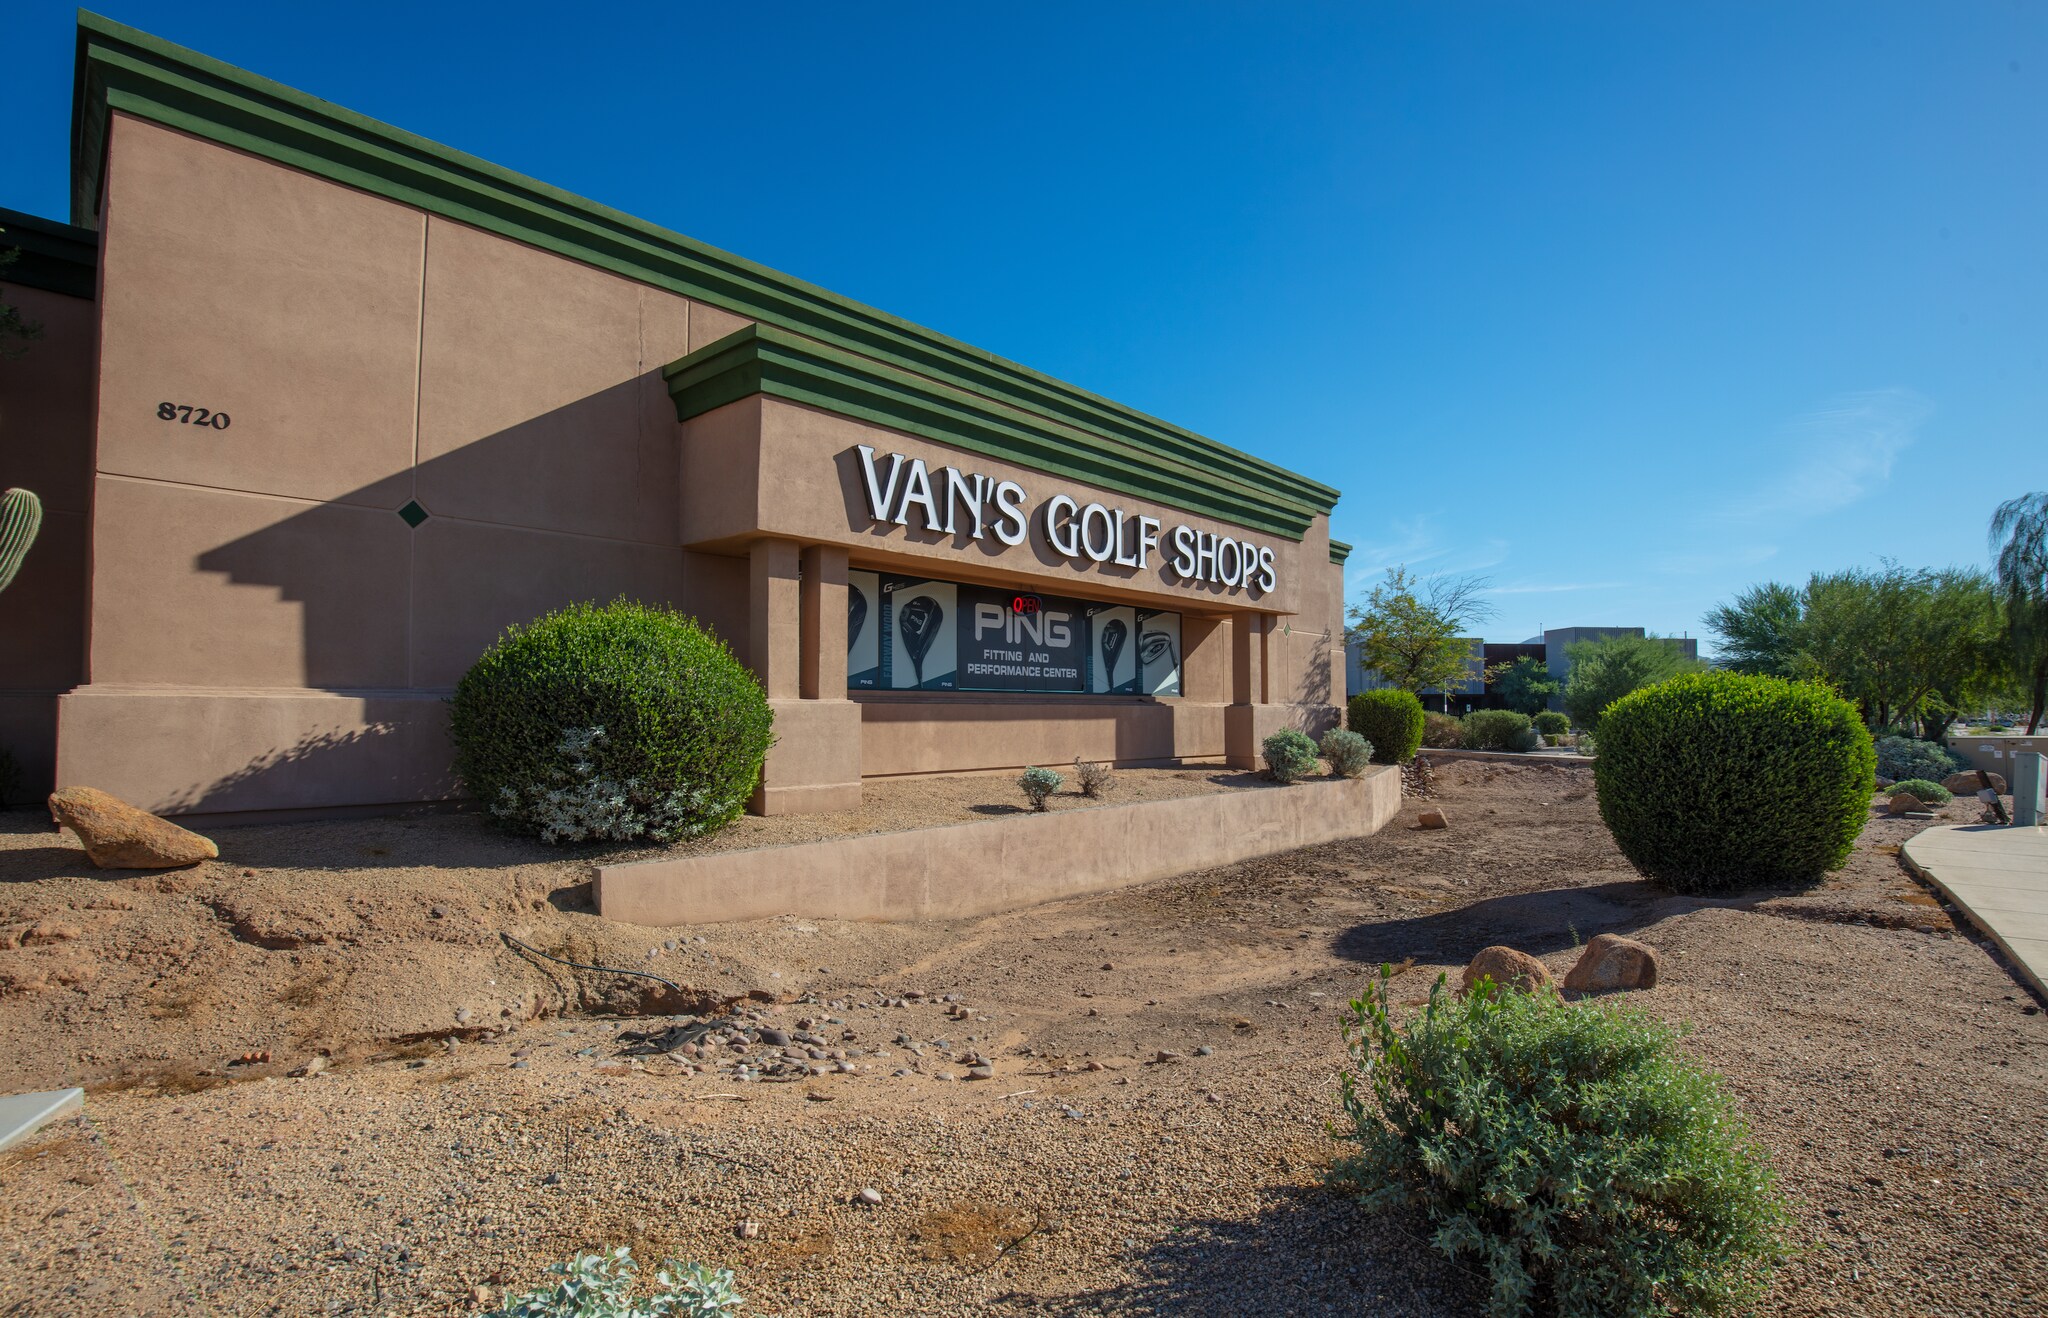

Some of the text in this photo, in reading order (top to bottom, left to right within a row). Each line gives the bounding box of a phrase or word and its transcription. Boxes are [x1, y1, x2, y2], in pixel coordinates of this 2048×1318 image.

[157, 402, 231, 430] 8720
[854, 443, 1277, 594] VAN'S GOLF SHOPS
[1013, 597, 1040, 613] OPEN
[975, 602, 1071, 648] PING
[883, 604, 892, 678] FAIRWAY WOOD
[983, 649, 1050, 663] FITTING AND
[967, 663, 1078, 678] PERFORMANCE CENTER
